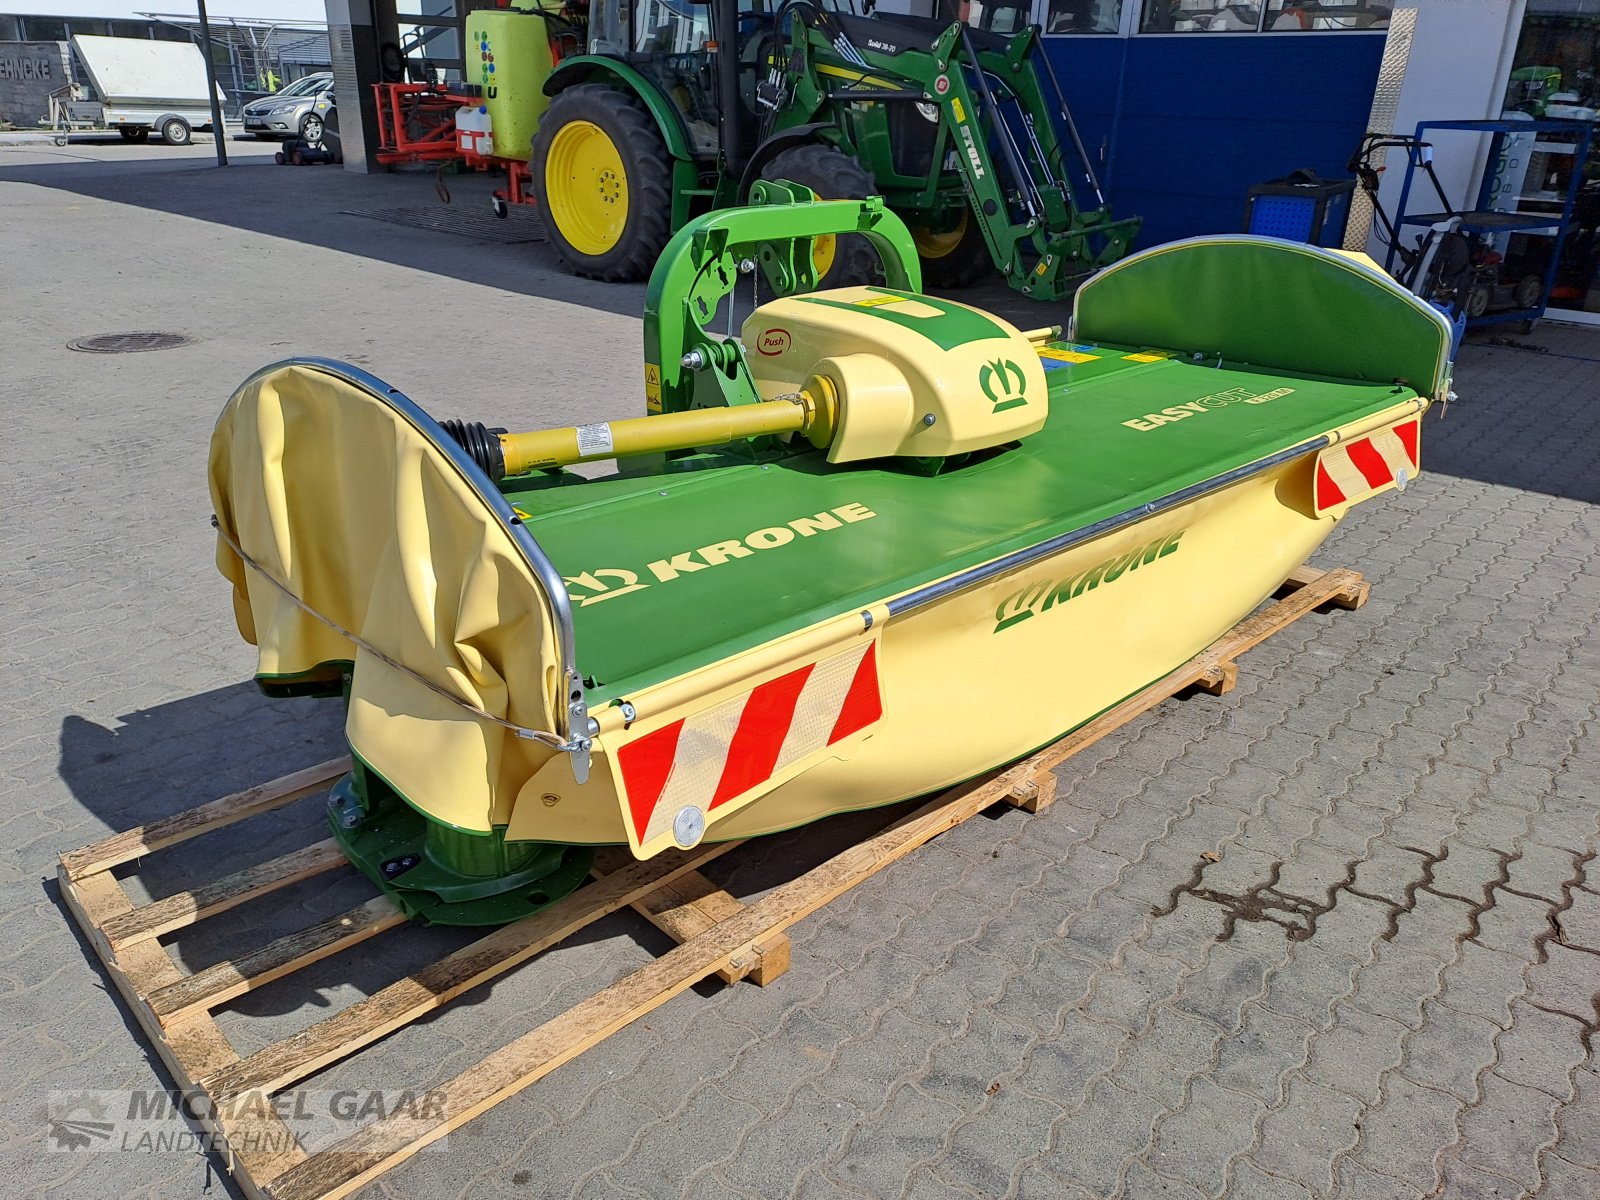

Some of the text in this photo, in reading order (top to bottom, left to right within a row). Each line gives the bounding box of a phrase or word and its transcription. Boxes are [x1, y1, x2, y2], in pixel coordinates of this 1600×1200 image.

[868, 39, 882, 49] Solid
[960, 125, 985, 180] STOLL
[764, 336, 784, 346] Push
[1120, 387, 1257, 432] EASYCUT
[646, 502, 878, 583] KRONE
[1040, 529, 1186, 613] KRONE
